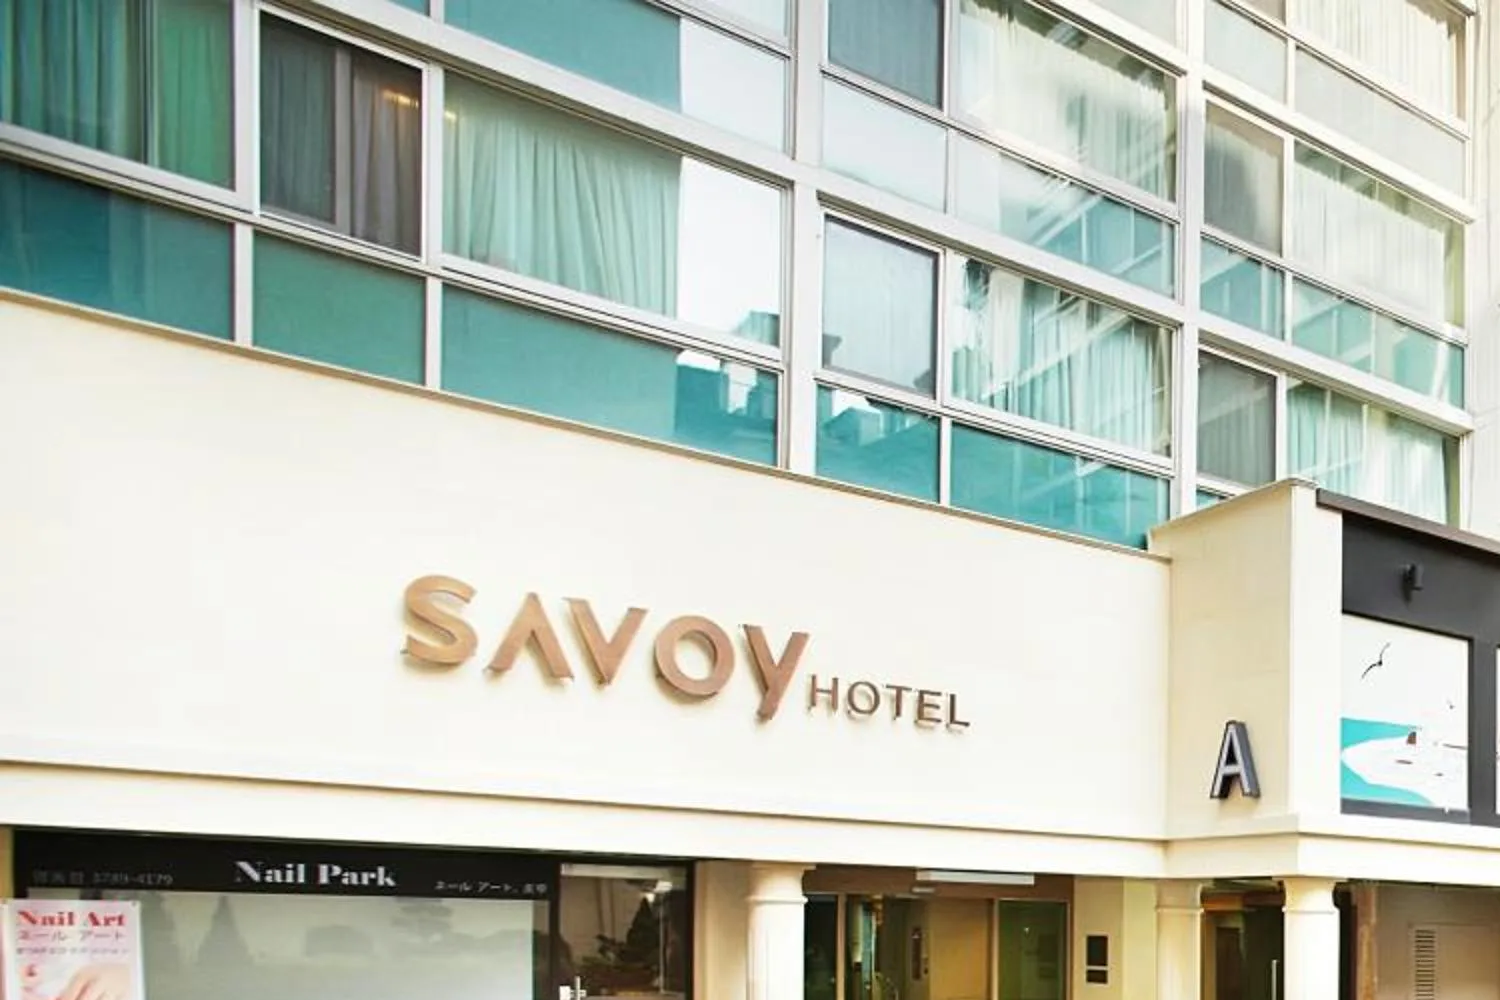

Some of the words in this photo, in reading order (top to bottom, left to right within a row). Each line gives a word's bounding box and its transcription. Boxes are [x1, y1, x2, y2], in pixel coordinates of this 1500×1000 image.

[402, 574, 810, 720] SAVOY
[808, 675, 971, 730] HOTEL
[1210, 720, 1261, 799] A
[234, 861, 306, 883] Nail
[318, 864, 396, 886] Park
[18, 911, 75, 926] Nail
[84, 911, 126, 926] Art
